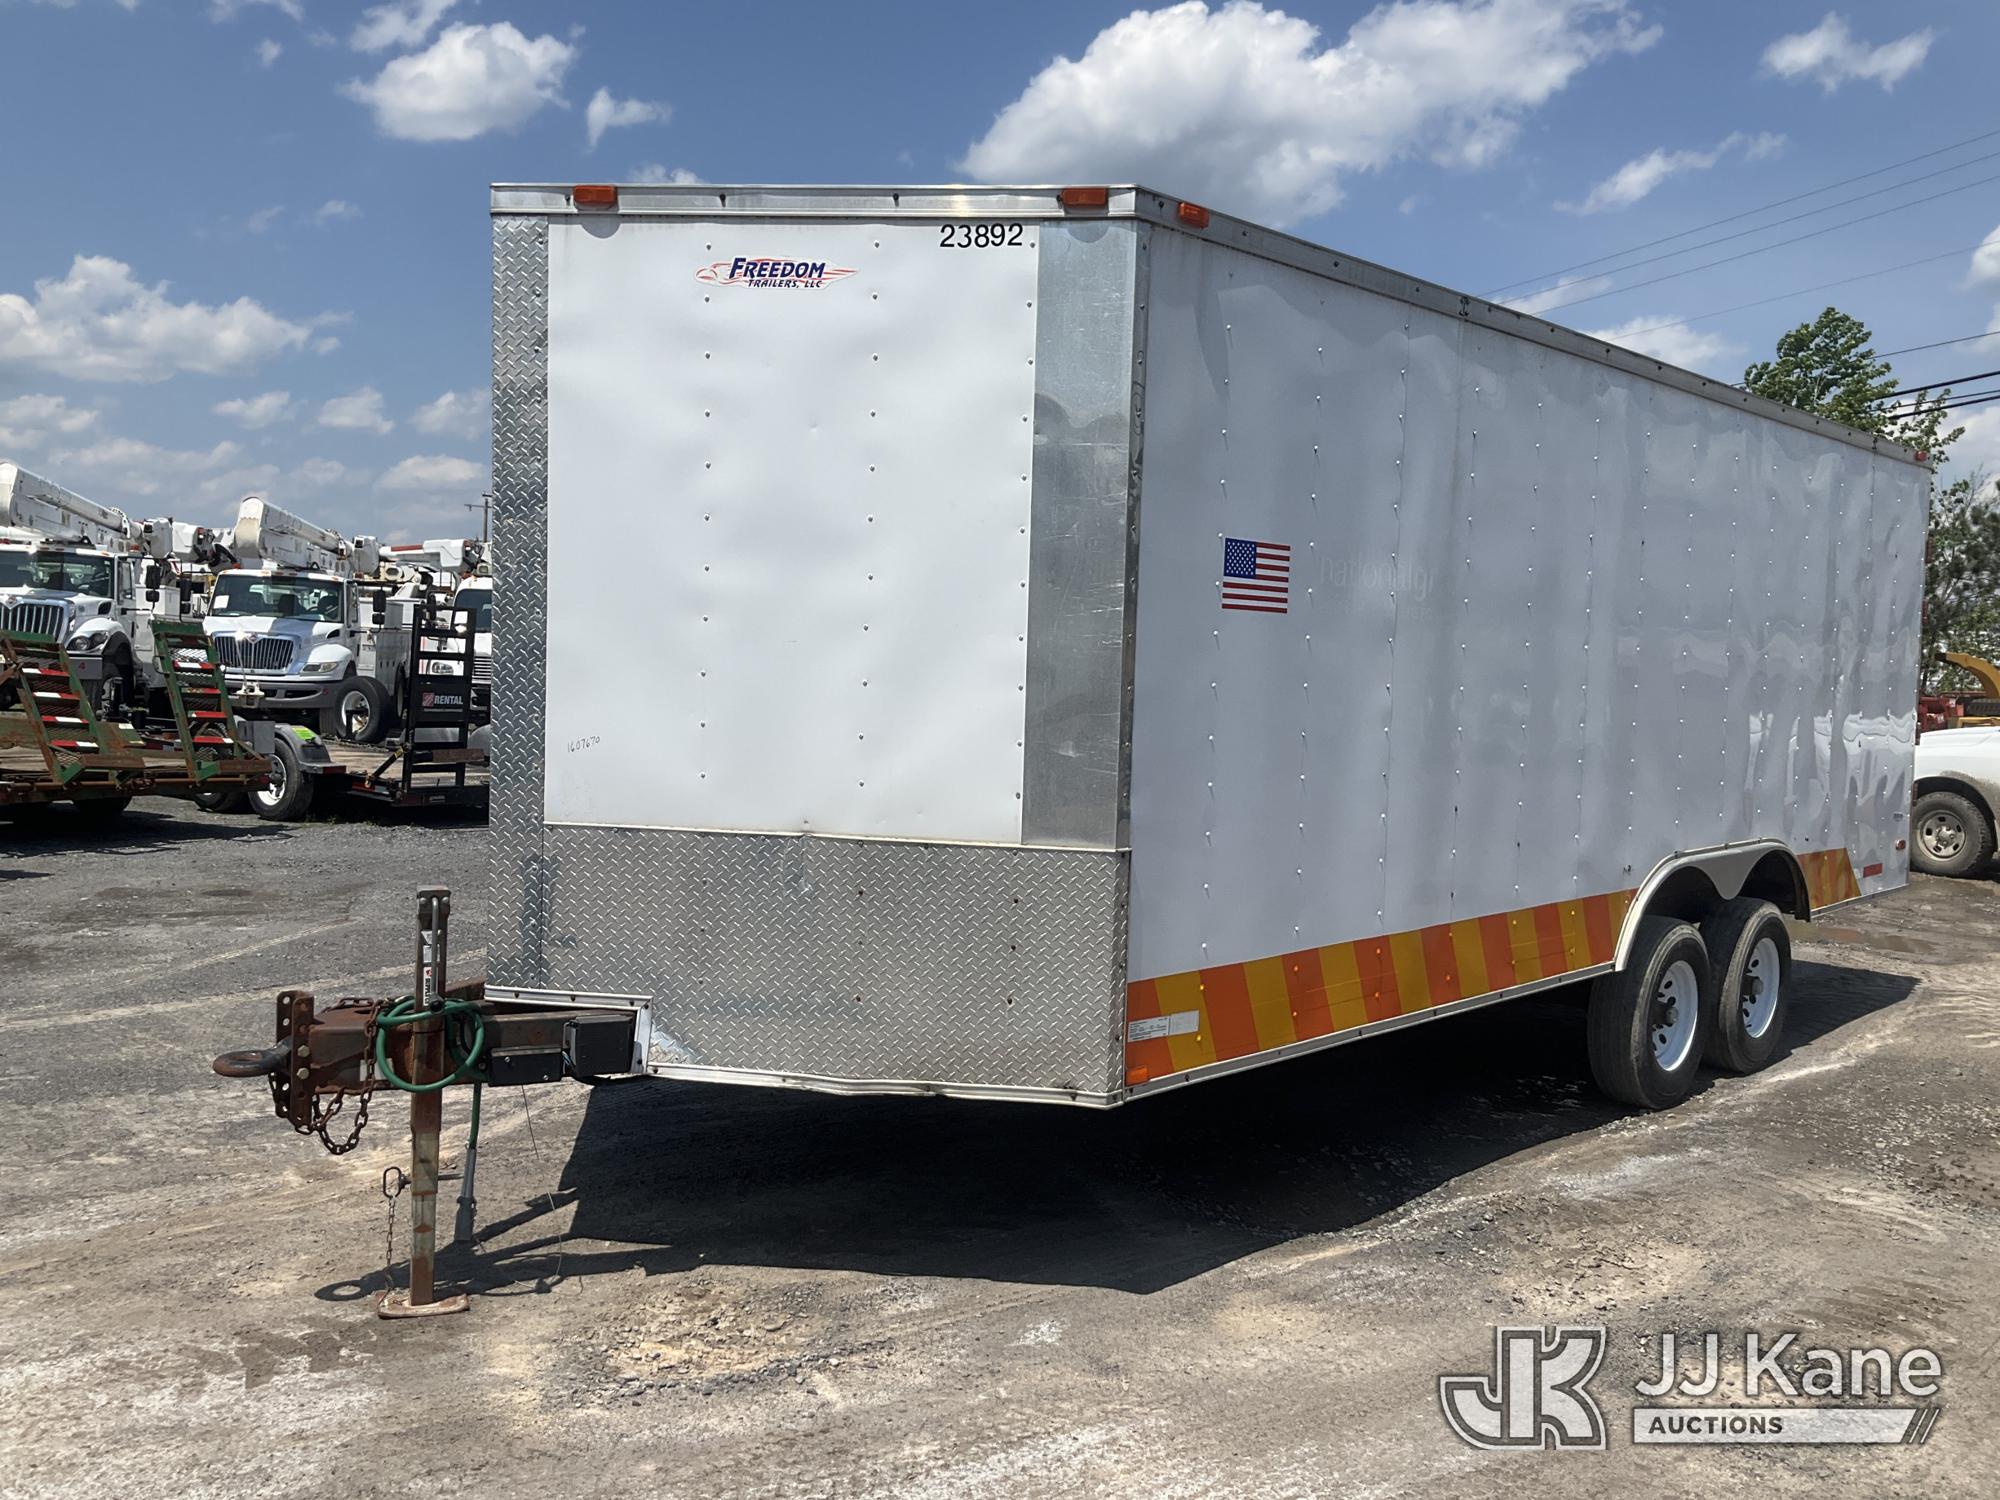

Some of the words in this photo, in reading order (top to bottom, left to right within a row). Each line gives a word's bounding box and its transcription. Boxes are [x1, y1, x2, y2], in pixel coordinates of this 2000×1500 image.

[940, 223, 1023, 248] 23892
[728, 257, 826, 279] FREEDOM
[748, 279, 800, 289] TRAILERS,
[804, 280, 823, 288] LLC
[434, 695, 464, 705] RENTAL
